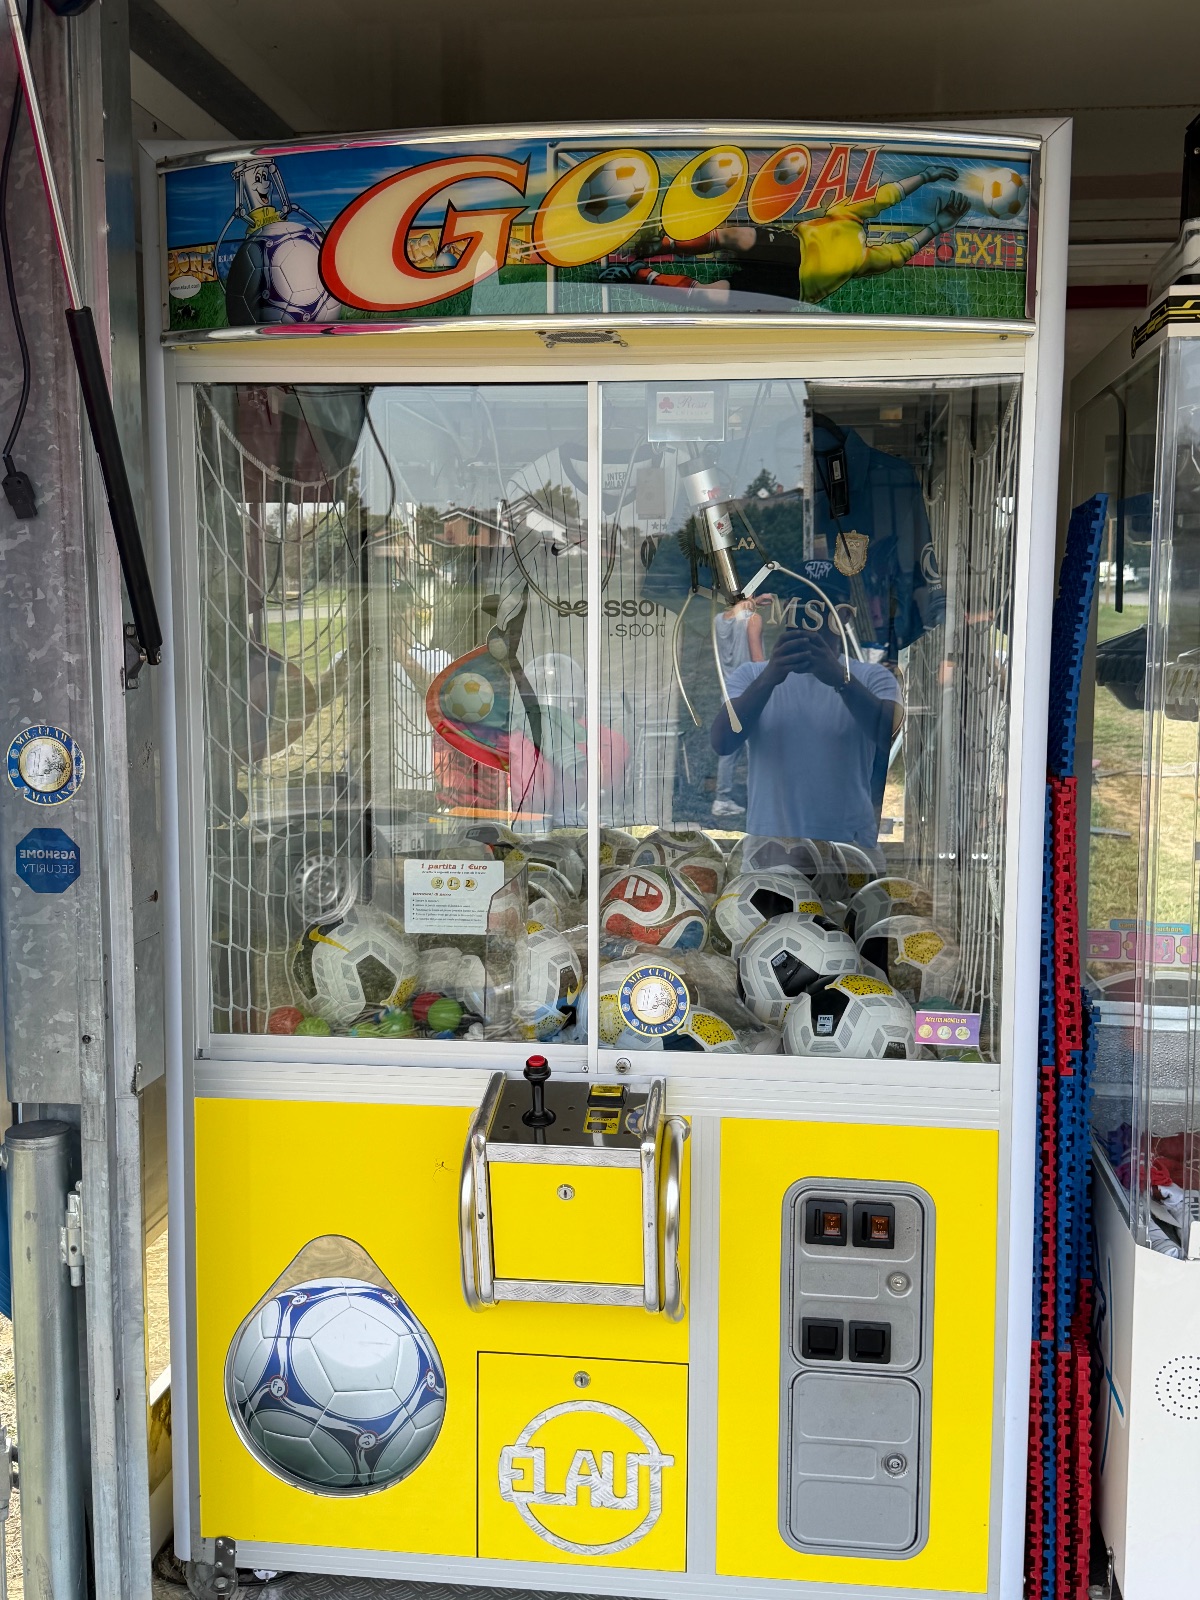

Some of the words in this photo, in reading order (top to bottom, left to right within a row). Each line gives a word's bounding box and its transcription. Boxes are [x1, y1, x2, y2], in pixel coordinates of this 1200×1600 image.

[766, 593, 857, 635] MSC
[648, 968, 675, 982] CLAW
[639, 1022, 674, 1034] MACAN
[498, 1445, 675, 1512] ELAUT
